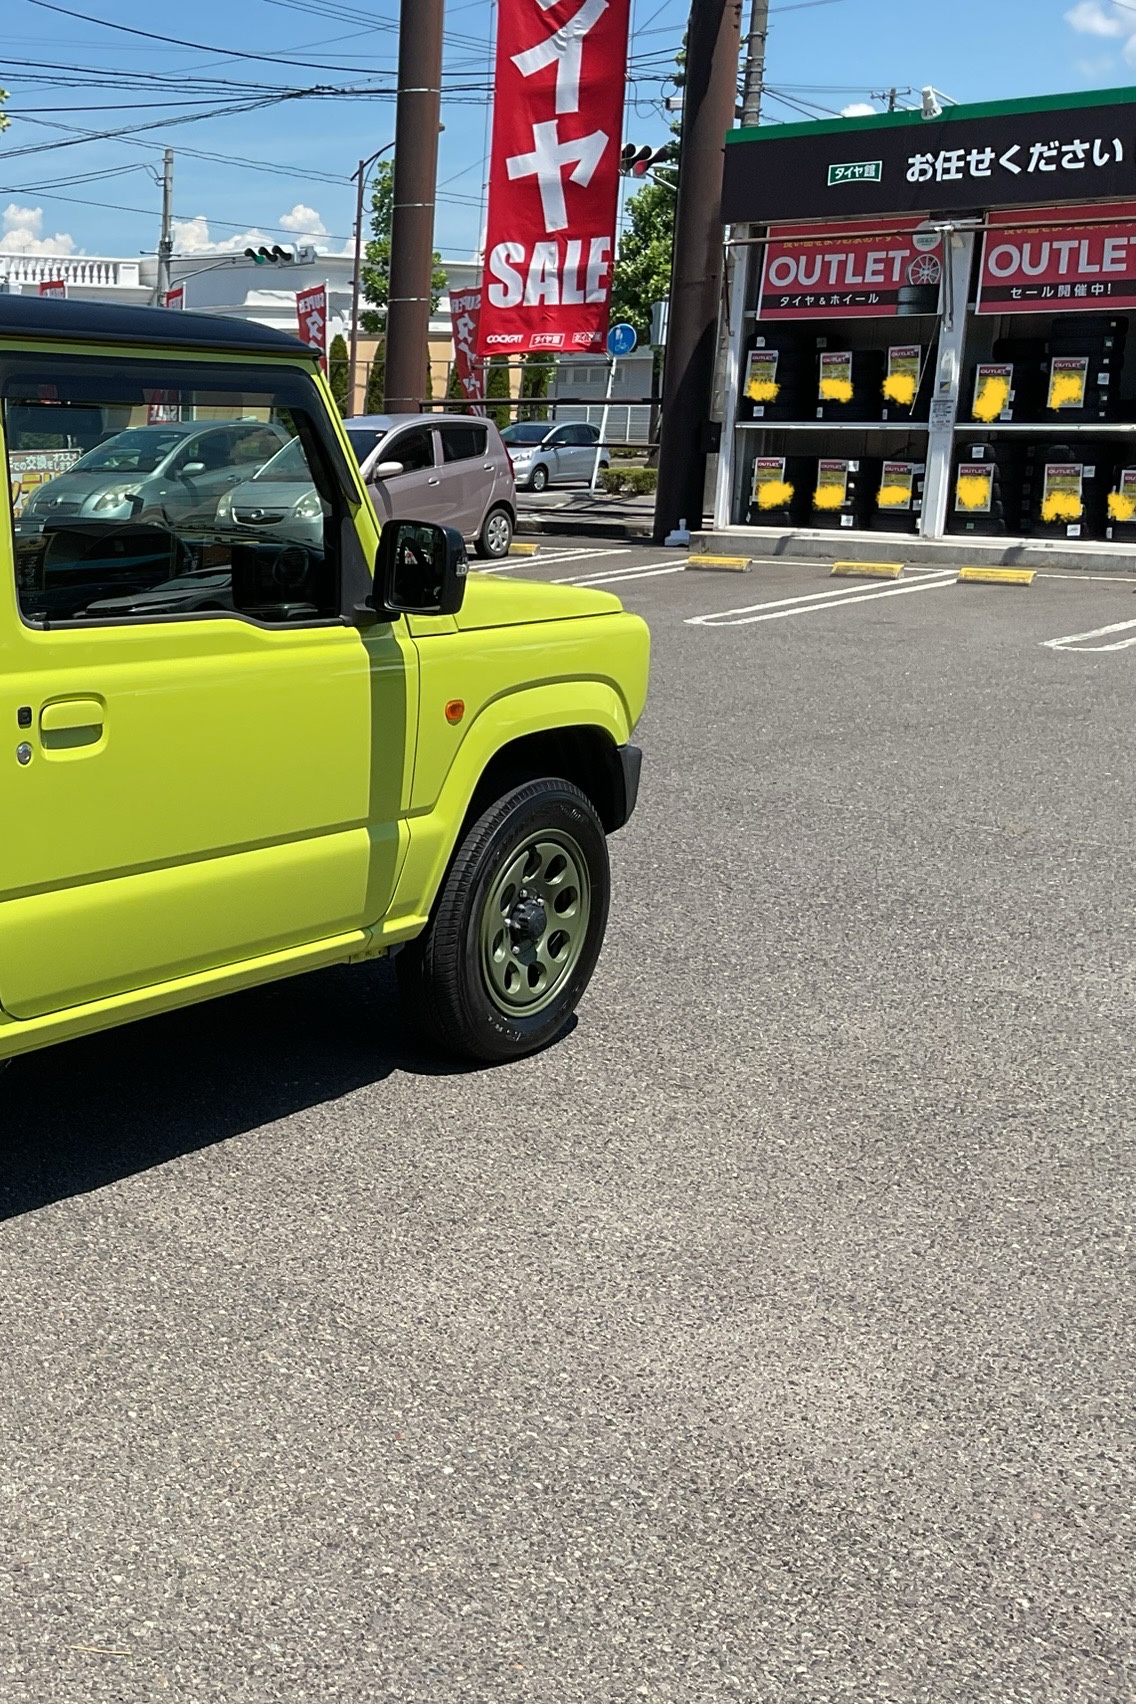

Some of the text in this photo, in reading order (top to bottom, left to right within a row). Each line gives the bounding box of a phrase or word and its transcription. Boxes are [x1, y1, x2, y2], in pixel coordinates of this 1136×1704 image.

[505, 0, 610, 233] イヤ
[834, 164, 876, 180] タイヤ館
[906, 138, 1124, 182] お任せください
[488, 236, 611, 309] SALE
[769, 249, 910, 287] OUTLET
[987, 237, 1136, 278] OUTLE
